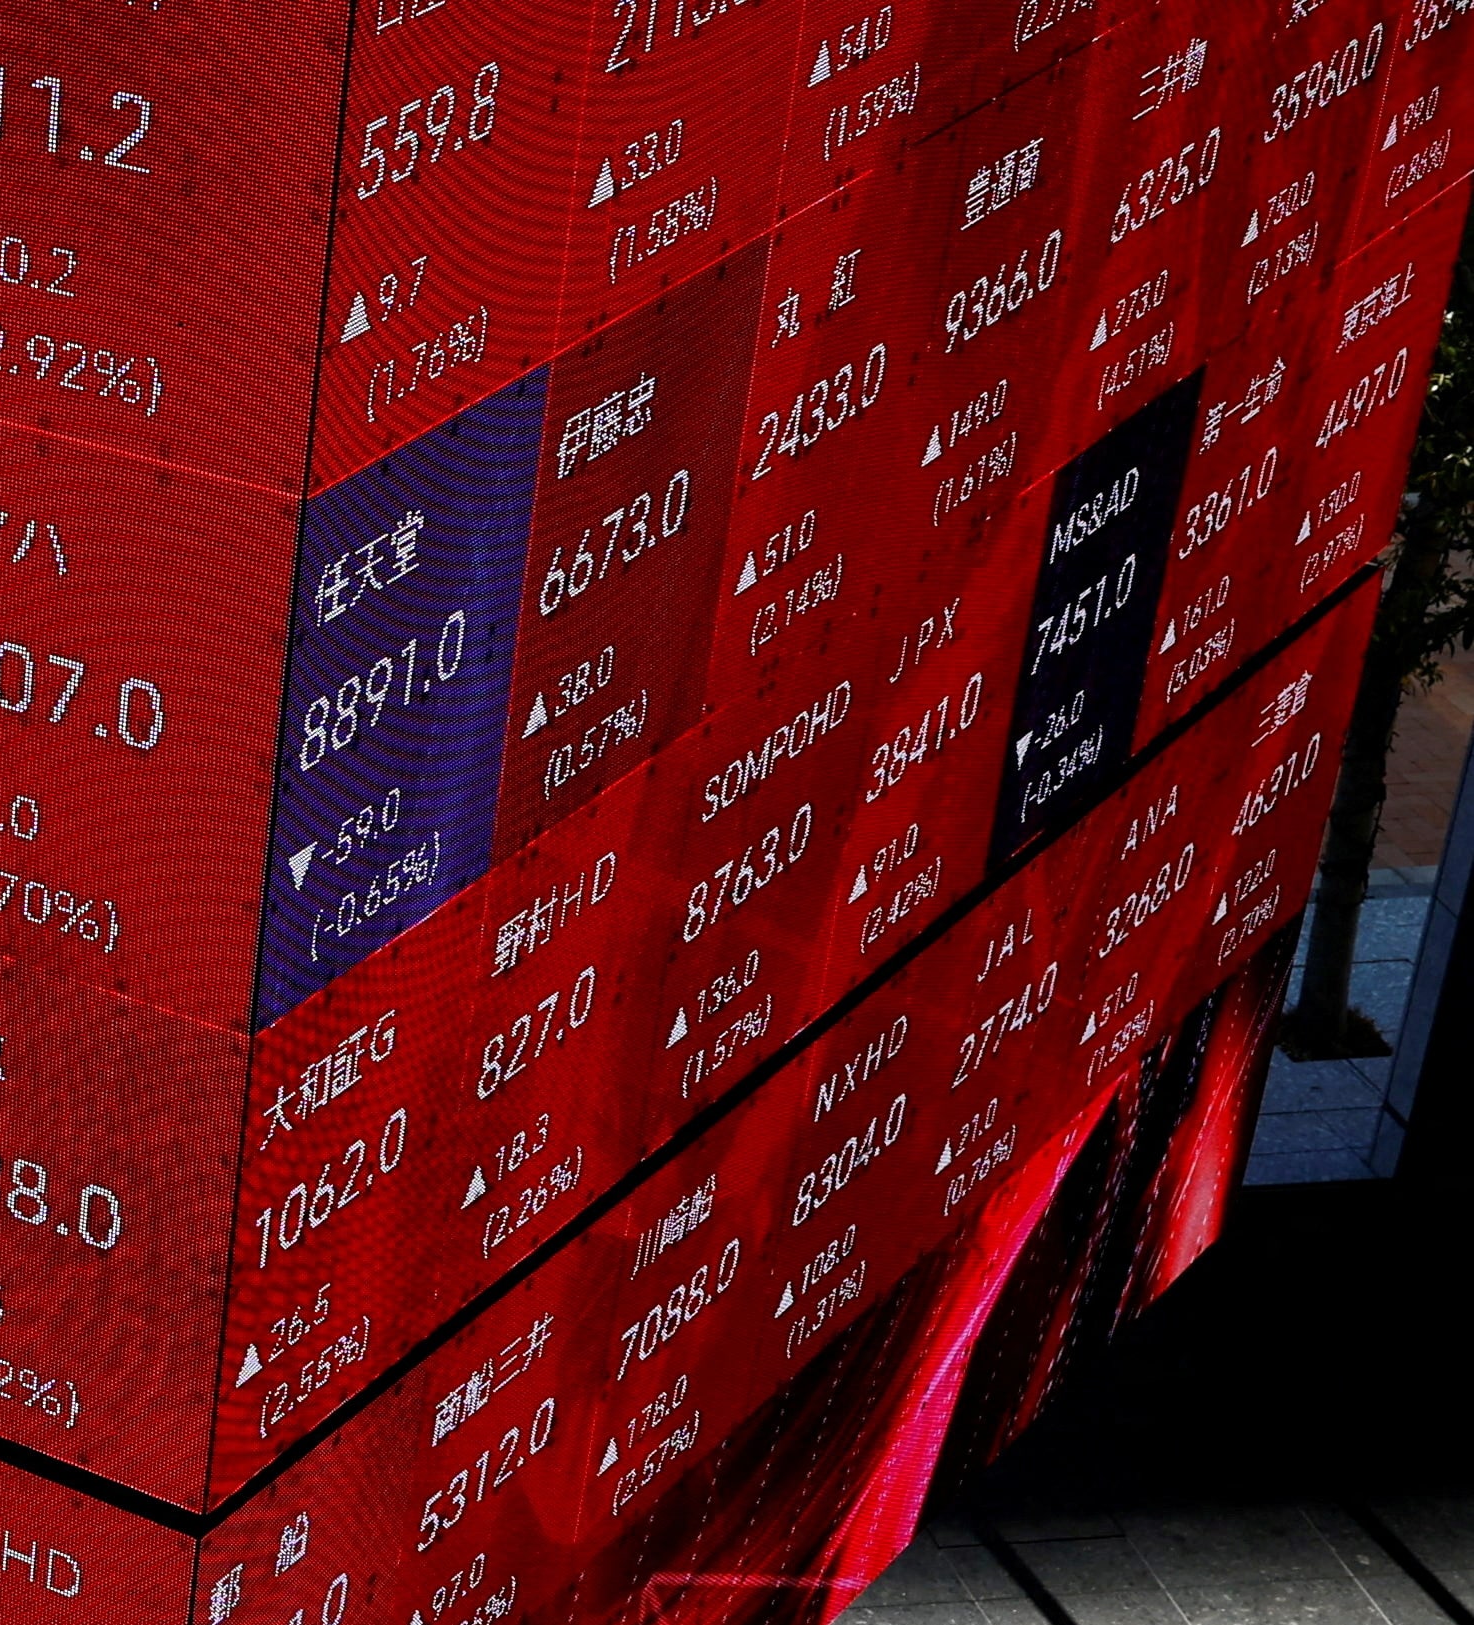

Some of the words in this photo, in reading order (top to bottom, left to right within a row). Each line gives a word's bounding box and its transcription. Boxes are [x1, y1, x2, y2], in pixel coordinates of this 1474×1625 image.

[357, 61, 499, 200] 559.8
[621, 119, 683, 190] 33.0
[1109, 127, 1220, 243] 6325.0
[610, 177, 717, 284] (1.58%)
[945, 229, 1062, 353] 9366.0
[367, 306, 488, 423] (1.76%)
[557, 372, 655, 479] 伊藤忠
[752, 343, 886, 481] 2433.0
[1315, 347, 1407, 448] 4497.0
[539, 469, 689, 616] 6673.0
[1049, 467, 1139, 564] MS&AD
[1179, 447, 1277, 559] 3361.0
[315, 510, 425, 624] 任天堂
[1031, 553, 1136, 675] 7451.0
[299, 610, 466, 771] 8891.0
[544, 689, 647, 799] (0.57%)
[702, 680, 851, 823] SOMPOHD
[866, 672, 982, 803] 3841.0
[322, 788, 401, 864] -59.0
[683, 803, 812, 943] 8763.0
[310, 831, 440, 962] (-0.65%)
[1099, 843, 1194, 958] 3268.0
[259, 1008, 397, 1151] 大和証G
[476, 966, 595, 1100] 827.0
[952, 961, 1058, 1088] 2774.0
[256, 1108, 407, 1268] 1062.0
[792, 1093, 906, 1226] 8304.0
[617, 1238, 740, 1381] 7088.0
[259, 1316, 370, 1438] (2.55%)
[417, 1397, 555, 1552] 5312.0
